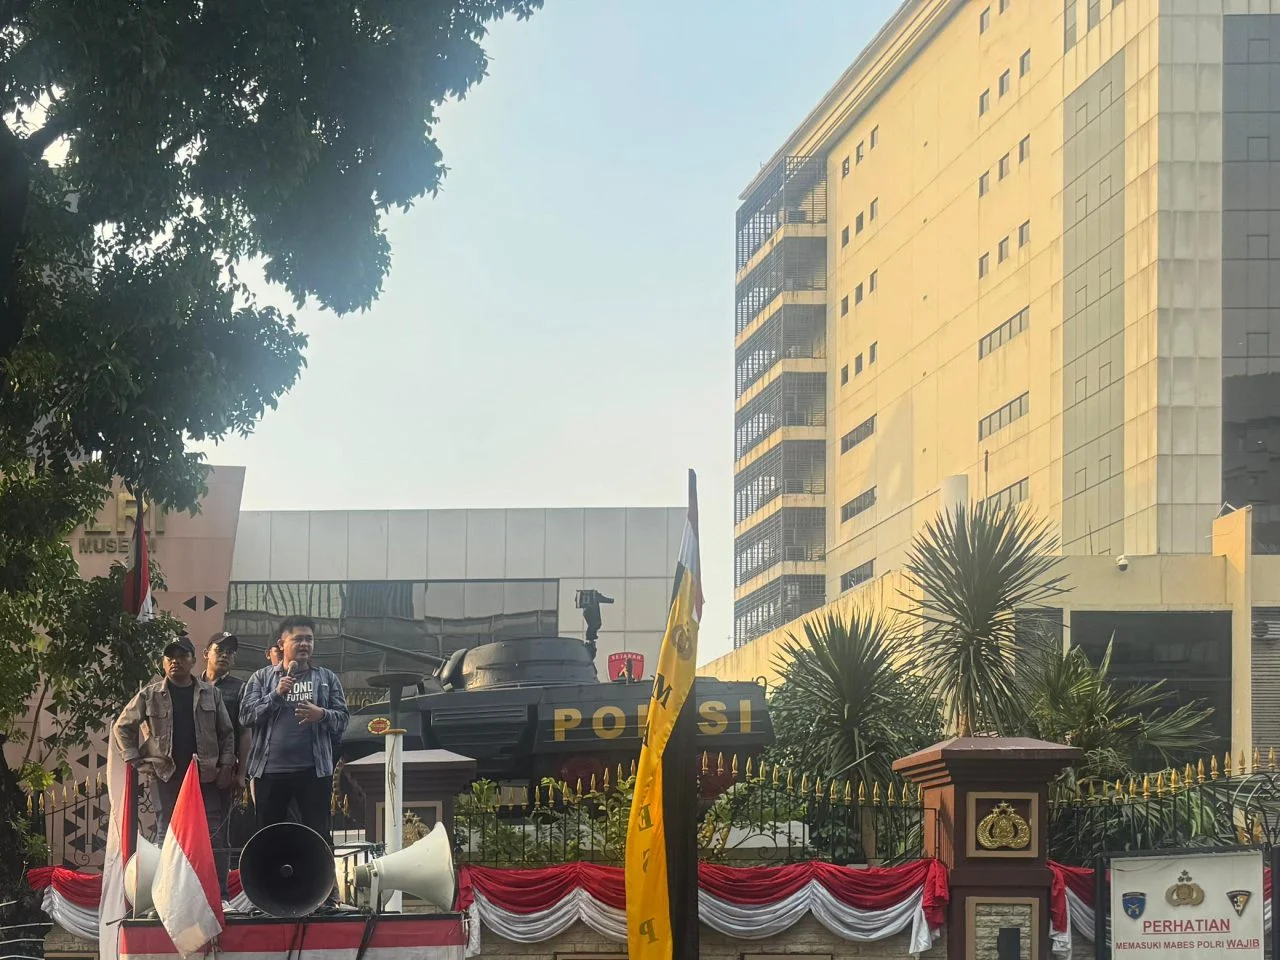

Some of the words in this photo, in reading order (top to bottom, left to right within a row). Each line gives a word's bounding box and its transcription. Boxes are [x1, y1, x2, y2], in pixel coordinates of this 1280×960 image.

[1142, 918, 1231, 933] PERHATIAN
[1115, 941, 1161, 950] MEMASUKI
[1163, 941, 1195, 950] MABES
[1197, 940, 1224, 949] POLRI
[1226, 938, 1260, 949] WAJIB
